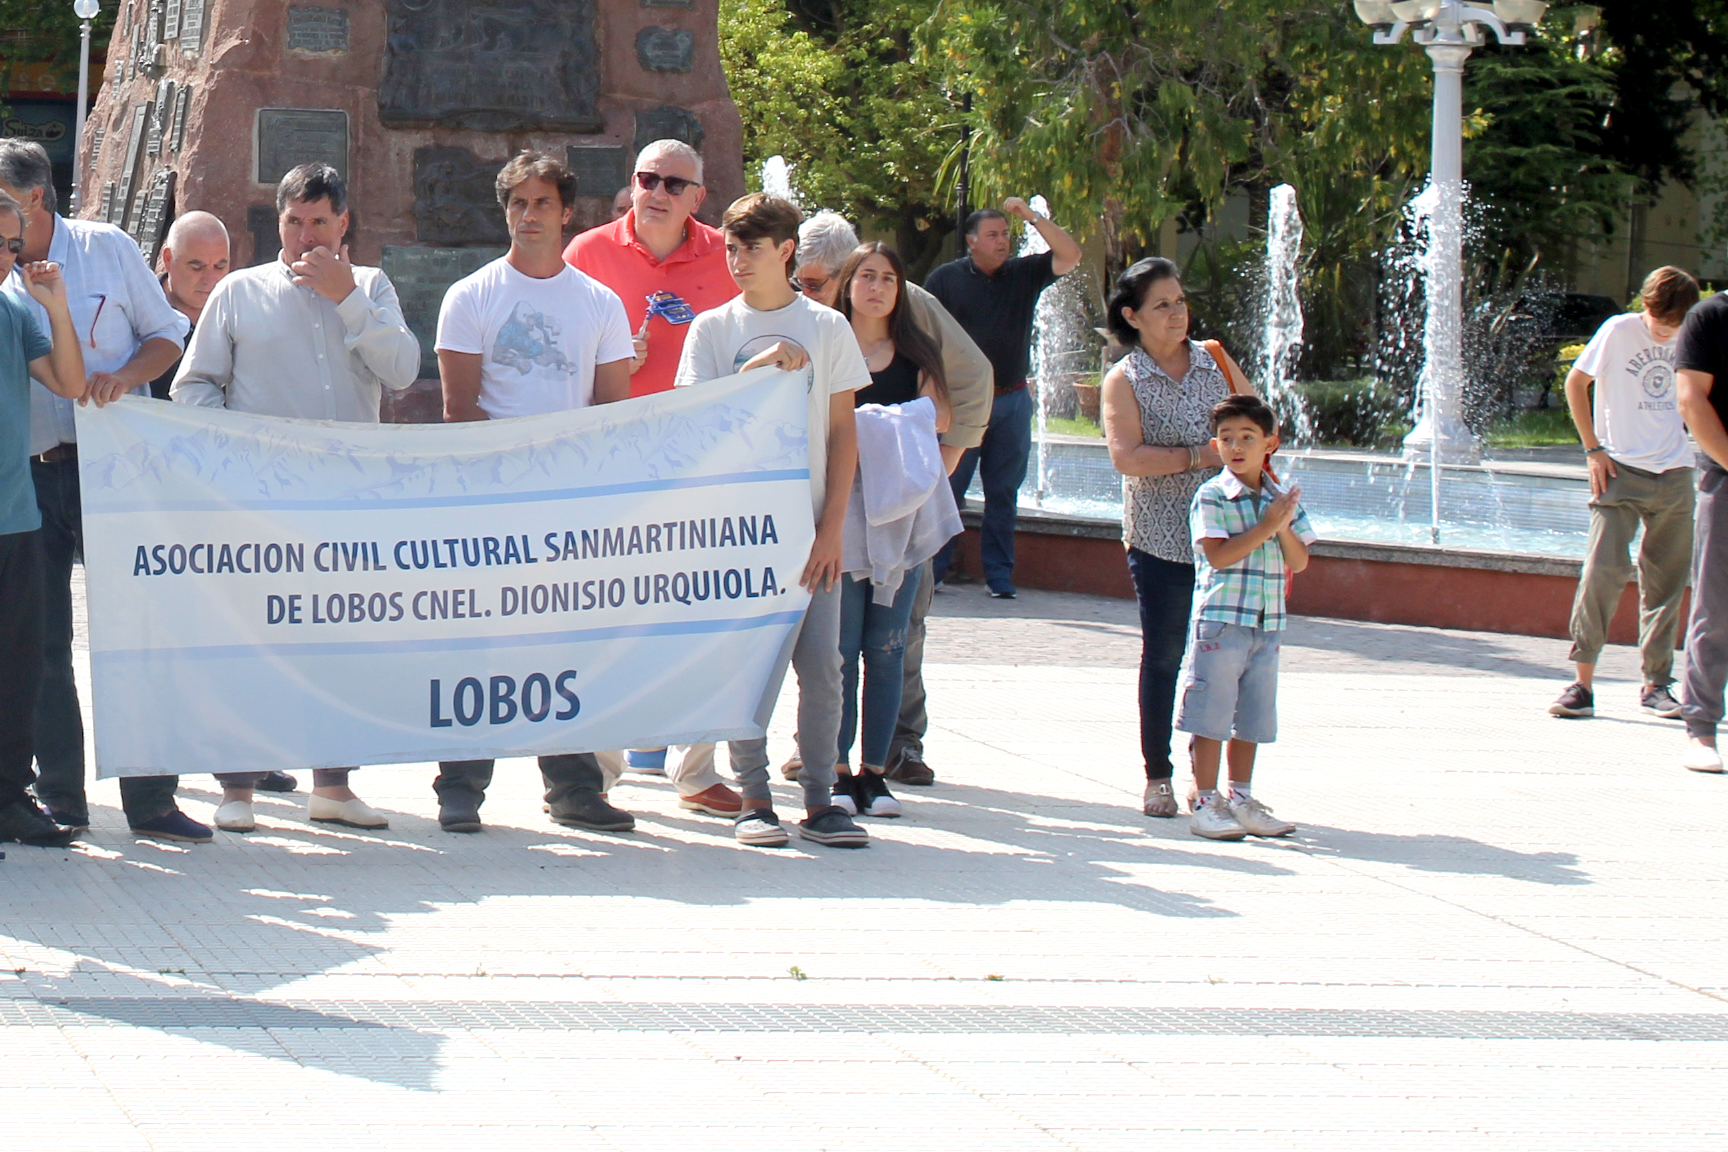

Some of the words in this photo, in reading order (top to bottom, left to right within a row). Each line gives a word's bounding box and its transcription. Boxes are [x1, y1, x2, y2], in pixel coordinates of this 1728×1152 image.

[133, 542, 305, 576] ASOCIACION
[313, 541, 387, 572] CIVIL
[393, 534, 538, 570] CULTURAL
[544, 514, 779, 562] SANMARTINIANA
[266, 594, 302, 624] DE
[312, 591, 404, 624] LOBOS
[412, 589, 491, 620] CNEL.
[501, 578, 625, 616] DIONISIO
[633, 566, 786, 606] URQUIOLA.
[430, 669, 581, 728] LOBOS
